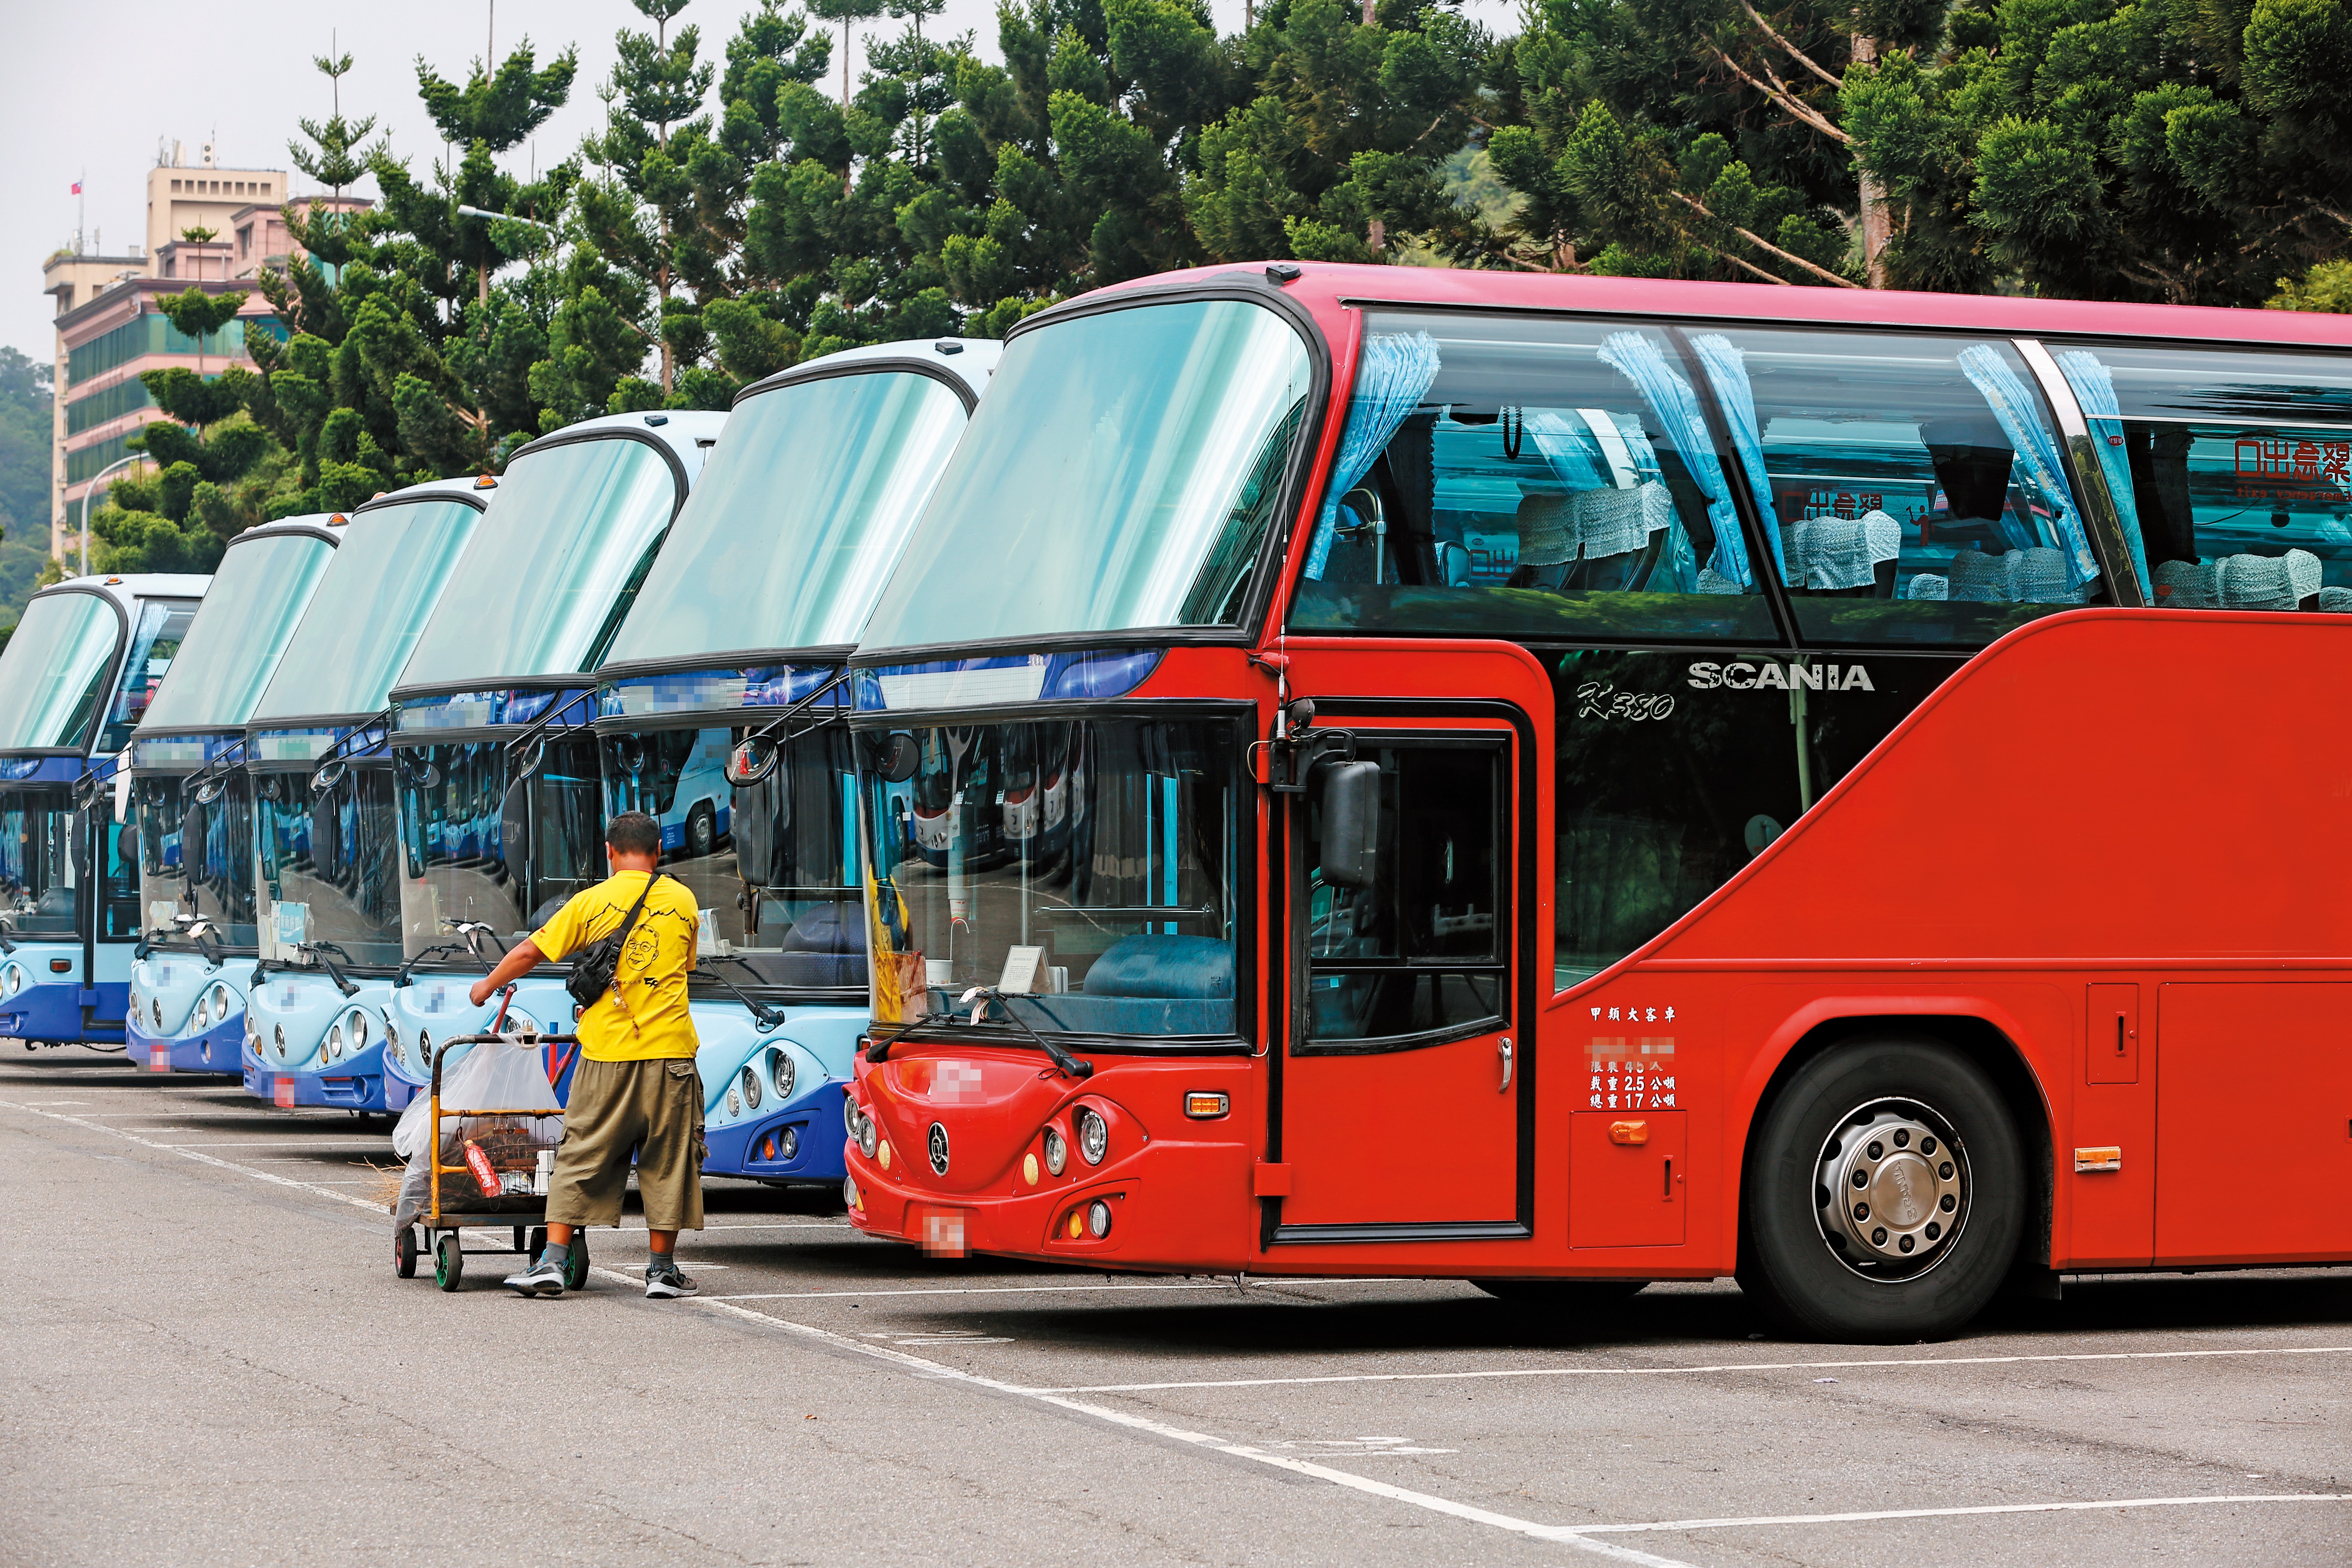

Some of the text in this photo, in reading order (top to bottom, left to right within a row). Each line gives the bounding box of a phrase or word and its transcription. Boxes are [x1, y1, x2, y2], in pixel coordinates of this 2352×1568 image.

[1688, 662, 1875, 691] SCANIA
[1590, 1006, 1675, 1023] 甲類大客車
[1893, 1161, 1918, 1221] SCANIA
